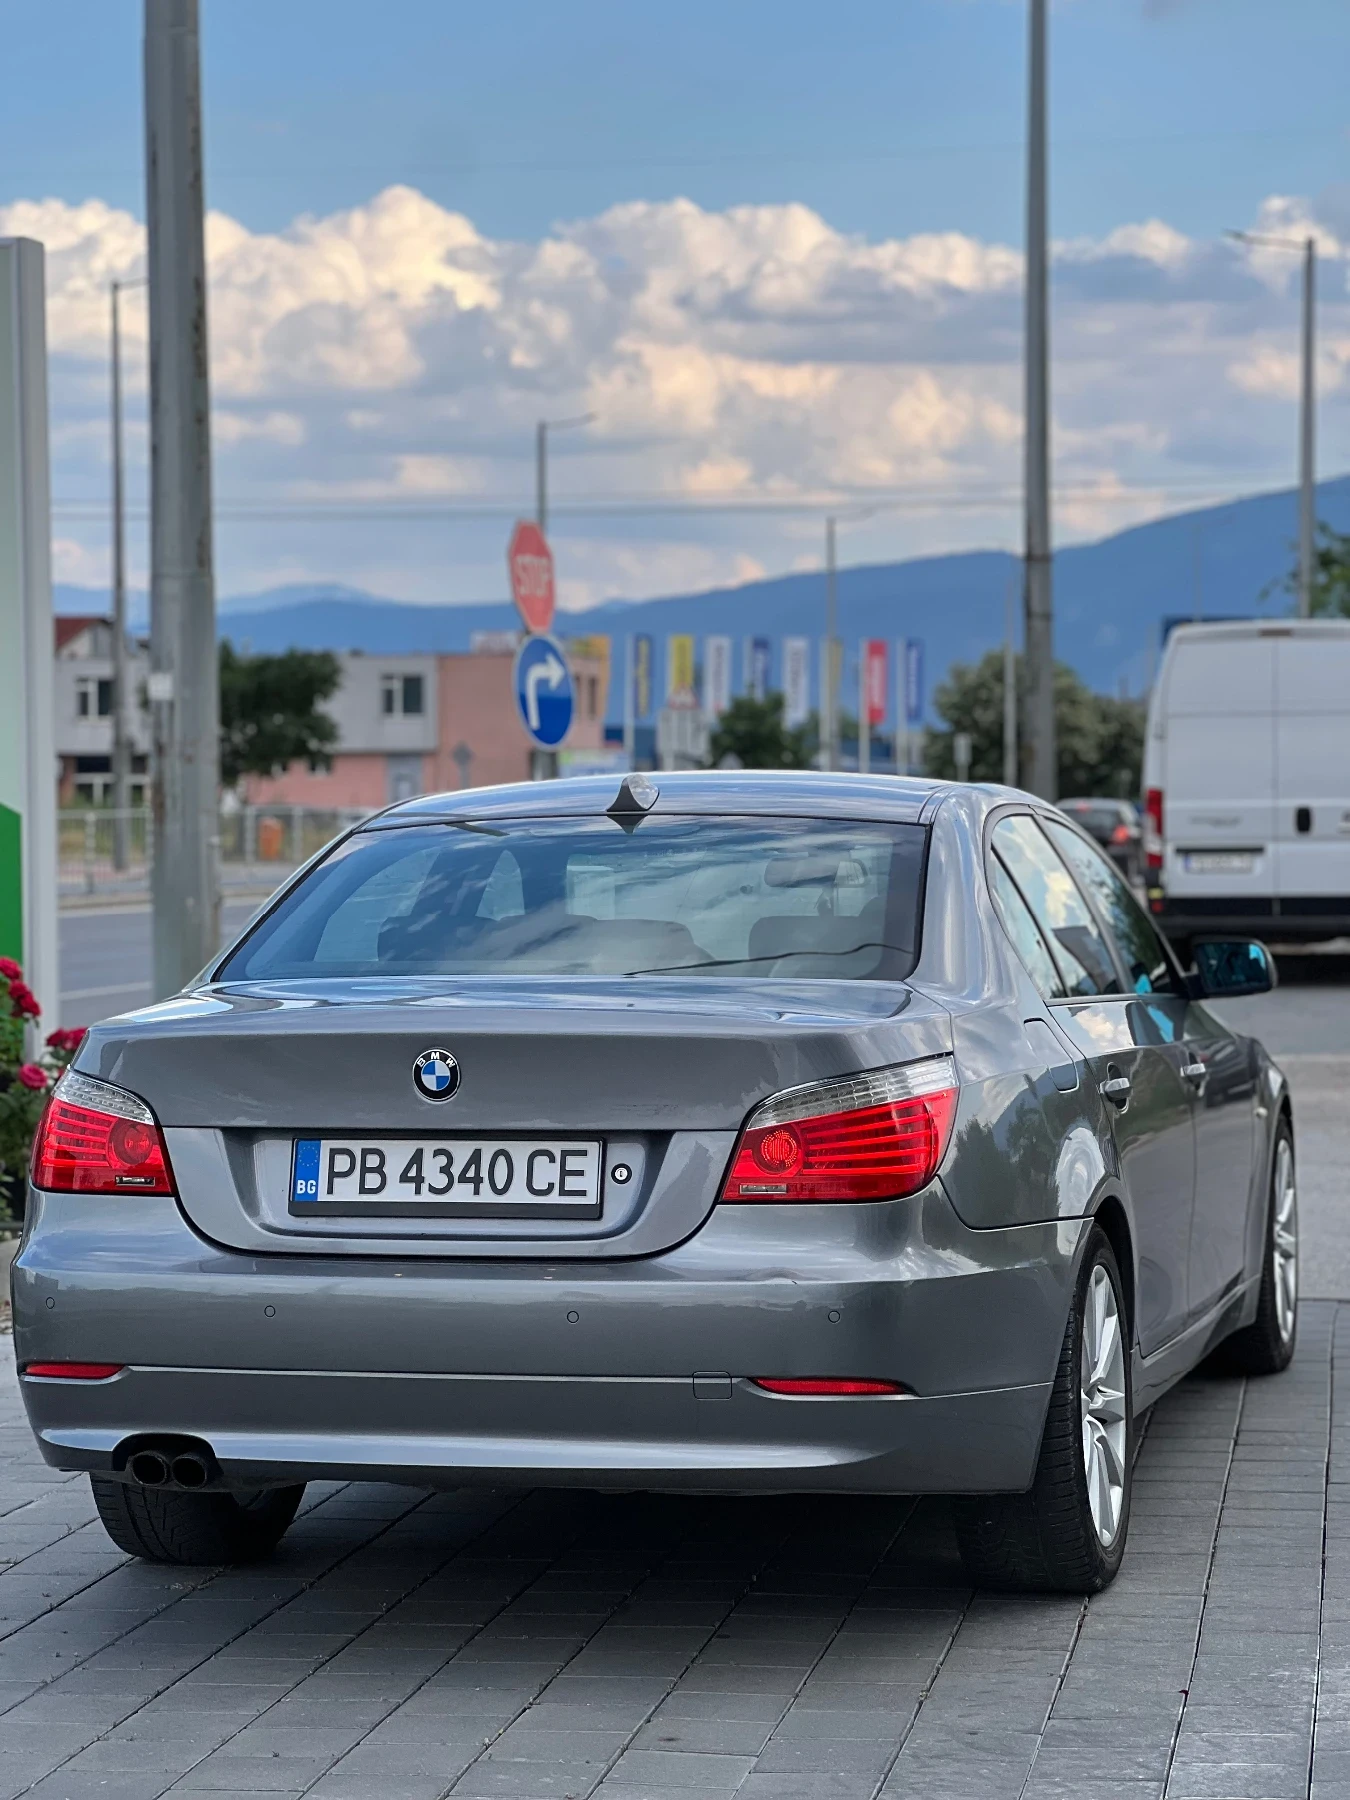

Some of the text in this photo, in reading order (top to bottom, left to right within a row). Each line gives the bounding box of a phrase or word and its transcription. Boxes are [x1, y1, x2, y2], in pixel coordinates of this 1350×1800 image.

[514, 554, 550, 597] STOP
[417, 1051, 456, 1068] BMW
[296, 1179, 317, 1194] BG
[326, 1147, 588, 1197] PB 4340 CE
